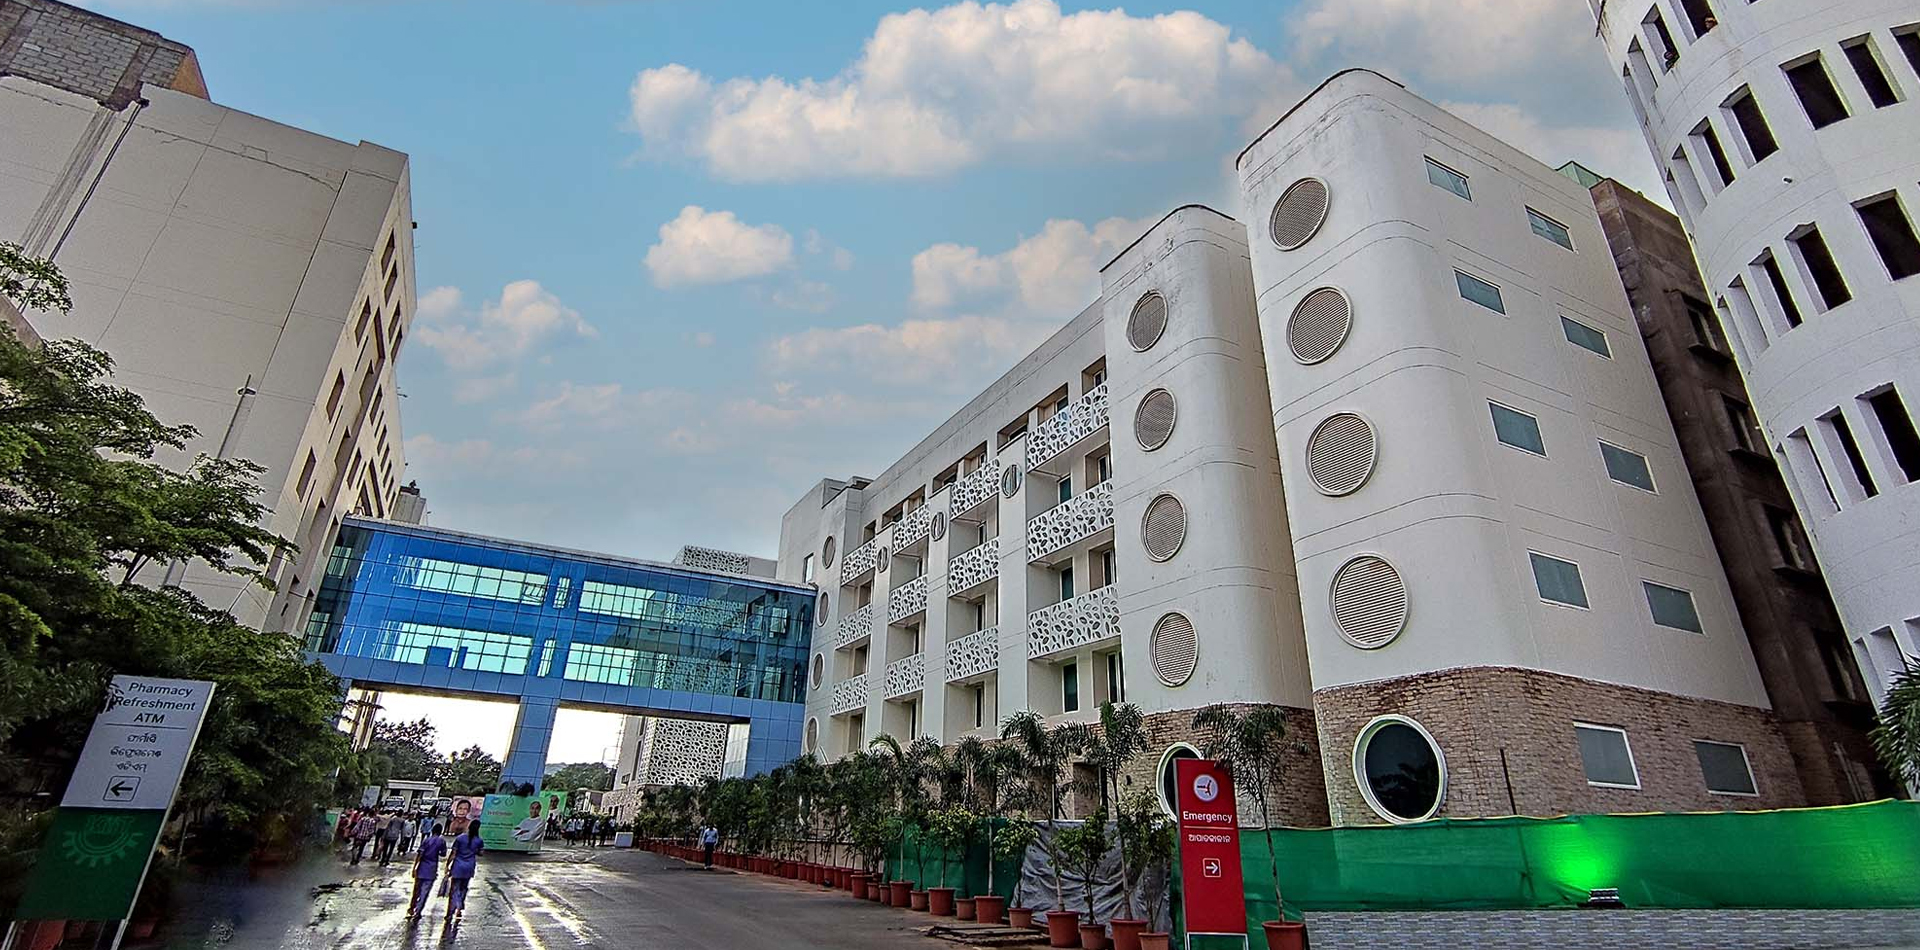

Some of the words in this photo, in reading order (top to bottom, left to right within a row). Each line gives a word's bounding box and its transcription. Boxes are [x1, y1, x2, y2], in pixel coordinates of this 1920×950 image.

[128, 682, 193, 698] Pharmacy
[115, 696, 196, 711] Refreshment
[133, 712, 165, 723] ATM
[1183, 811, 1233, 824] Emergency
